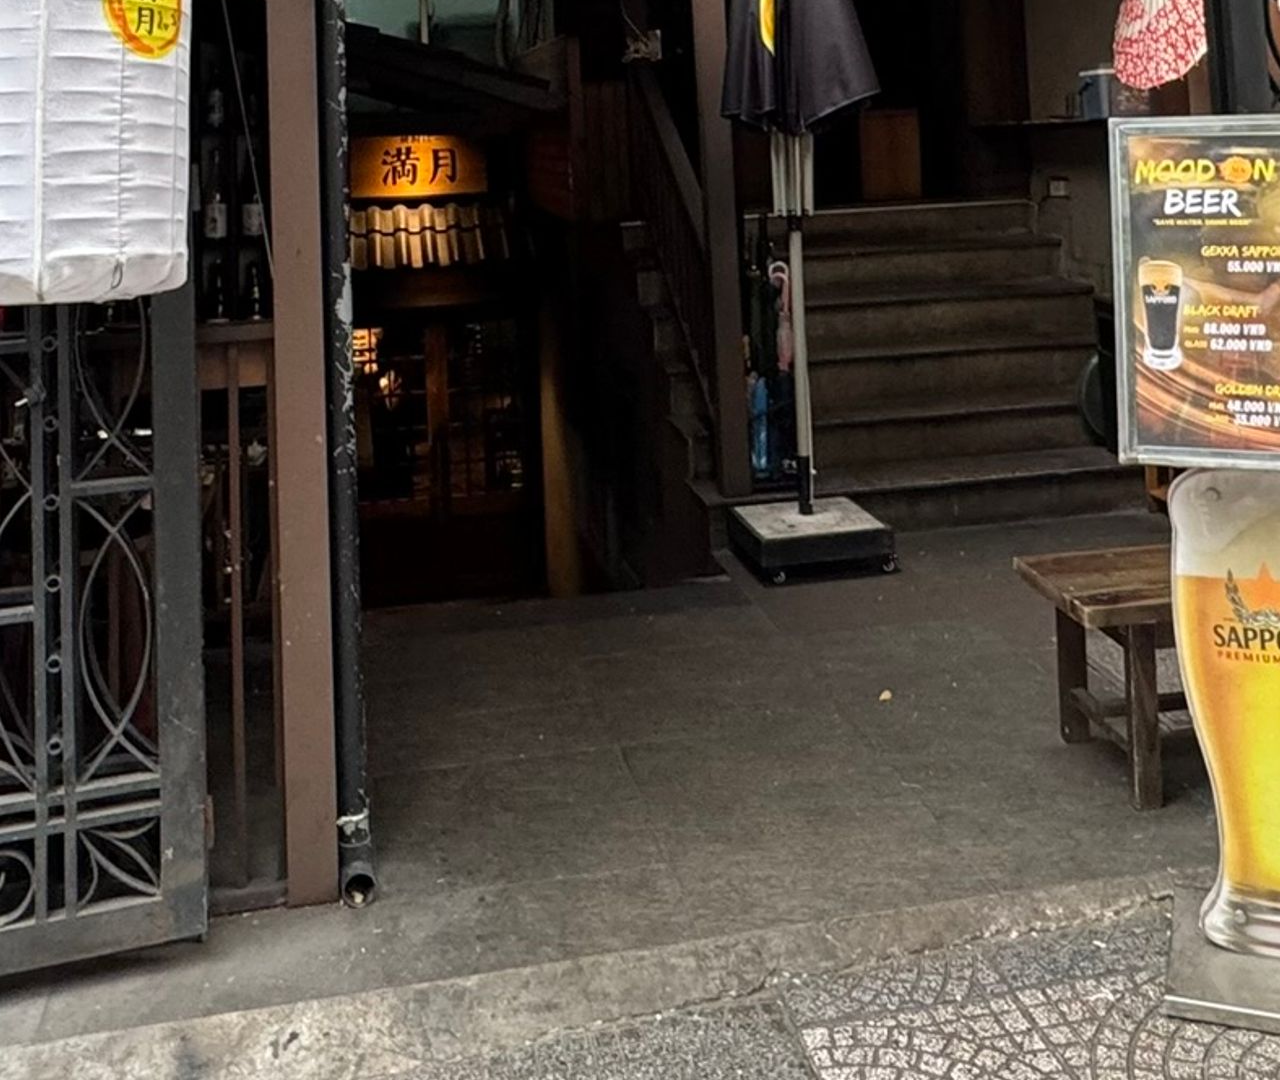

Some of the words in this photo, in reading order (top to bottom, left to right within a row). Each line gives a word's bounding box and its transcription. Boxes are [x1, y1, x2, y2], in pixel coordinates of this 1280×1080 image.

[380, 145, 459, 187] 満月
[1134, 158, 1216, 185] MOOD
[1163, 188, 1242, 218] BEER
[1200, 244, 1240, 258] GEKKA
[1182, 304, 1221, 318] BLACK
[1221, 305, 1261, 318] DRAFT
[1242, 323, 1267, 336] VND
[1248, 339, 1273, 352] VND
[1214, 383, 1263, 397] GOLDEN
